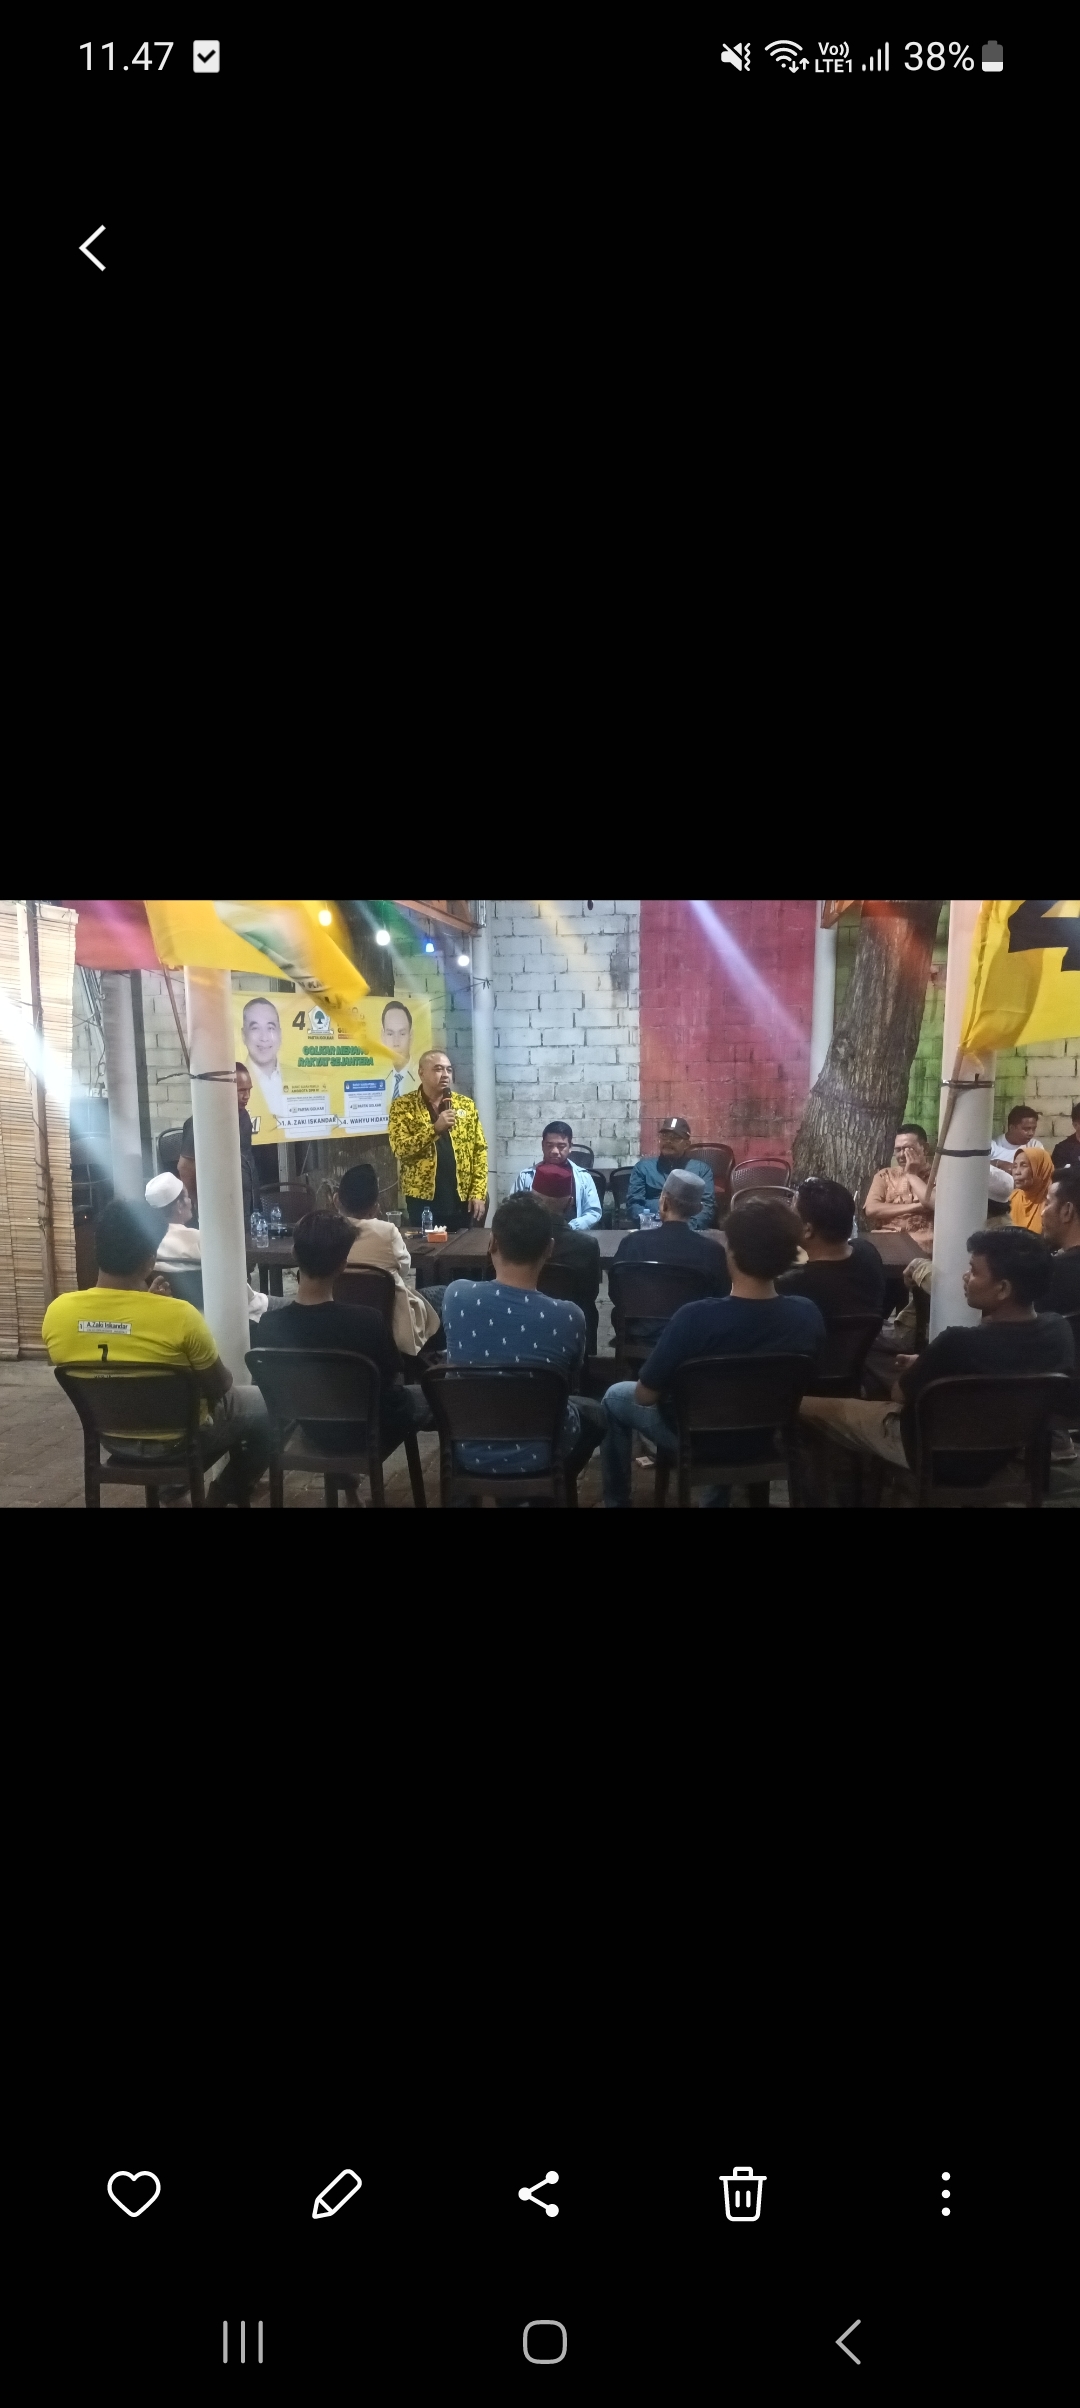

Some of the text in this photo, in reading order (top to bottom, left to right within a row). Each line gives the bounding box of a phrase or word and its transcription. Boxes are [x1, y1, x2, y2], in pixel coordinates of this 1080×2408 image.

[80, 42, 174, 71] 11.47
[904, 41, 975, 71] 38%
[815, 59, 852, 73] LTE1
[292, 1011, 306, 1030] 4
[303, 1045, 336, 1055] GOLKAR
[297, 1057, 330, 1067] RAKYAT
[307, 1117, 336, 1125] ISKANDAR
[104, 1322, 128, 1330] Iskandar
